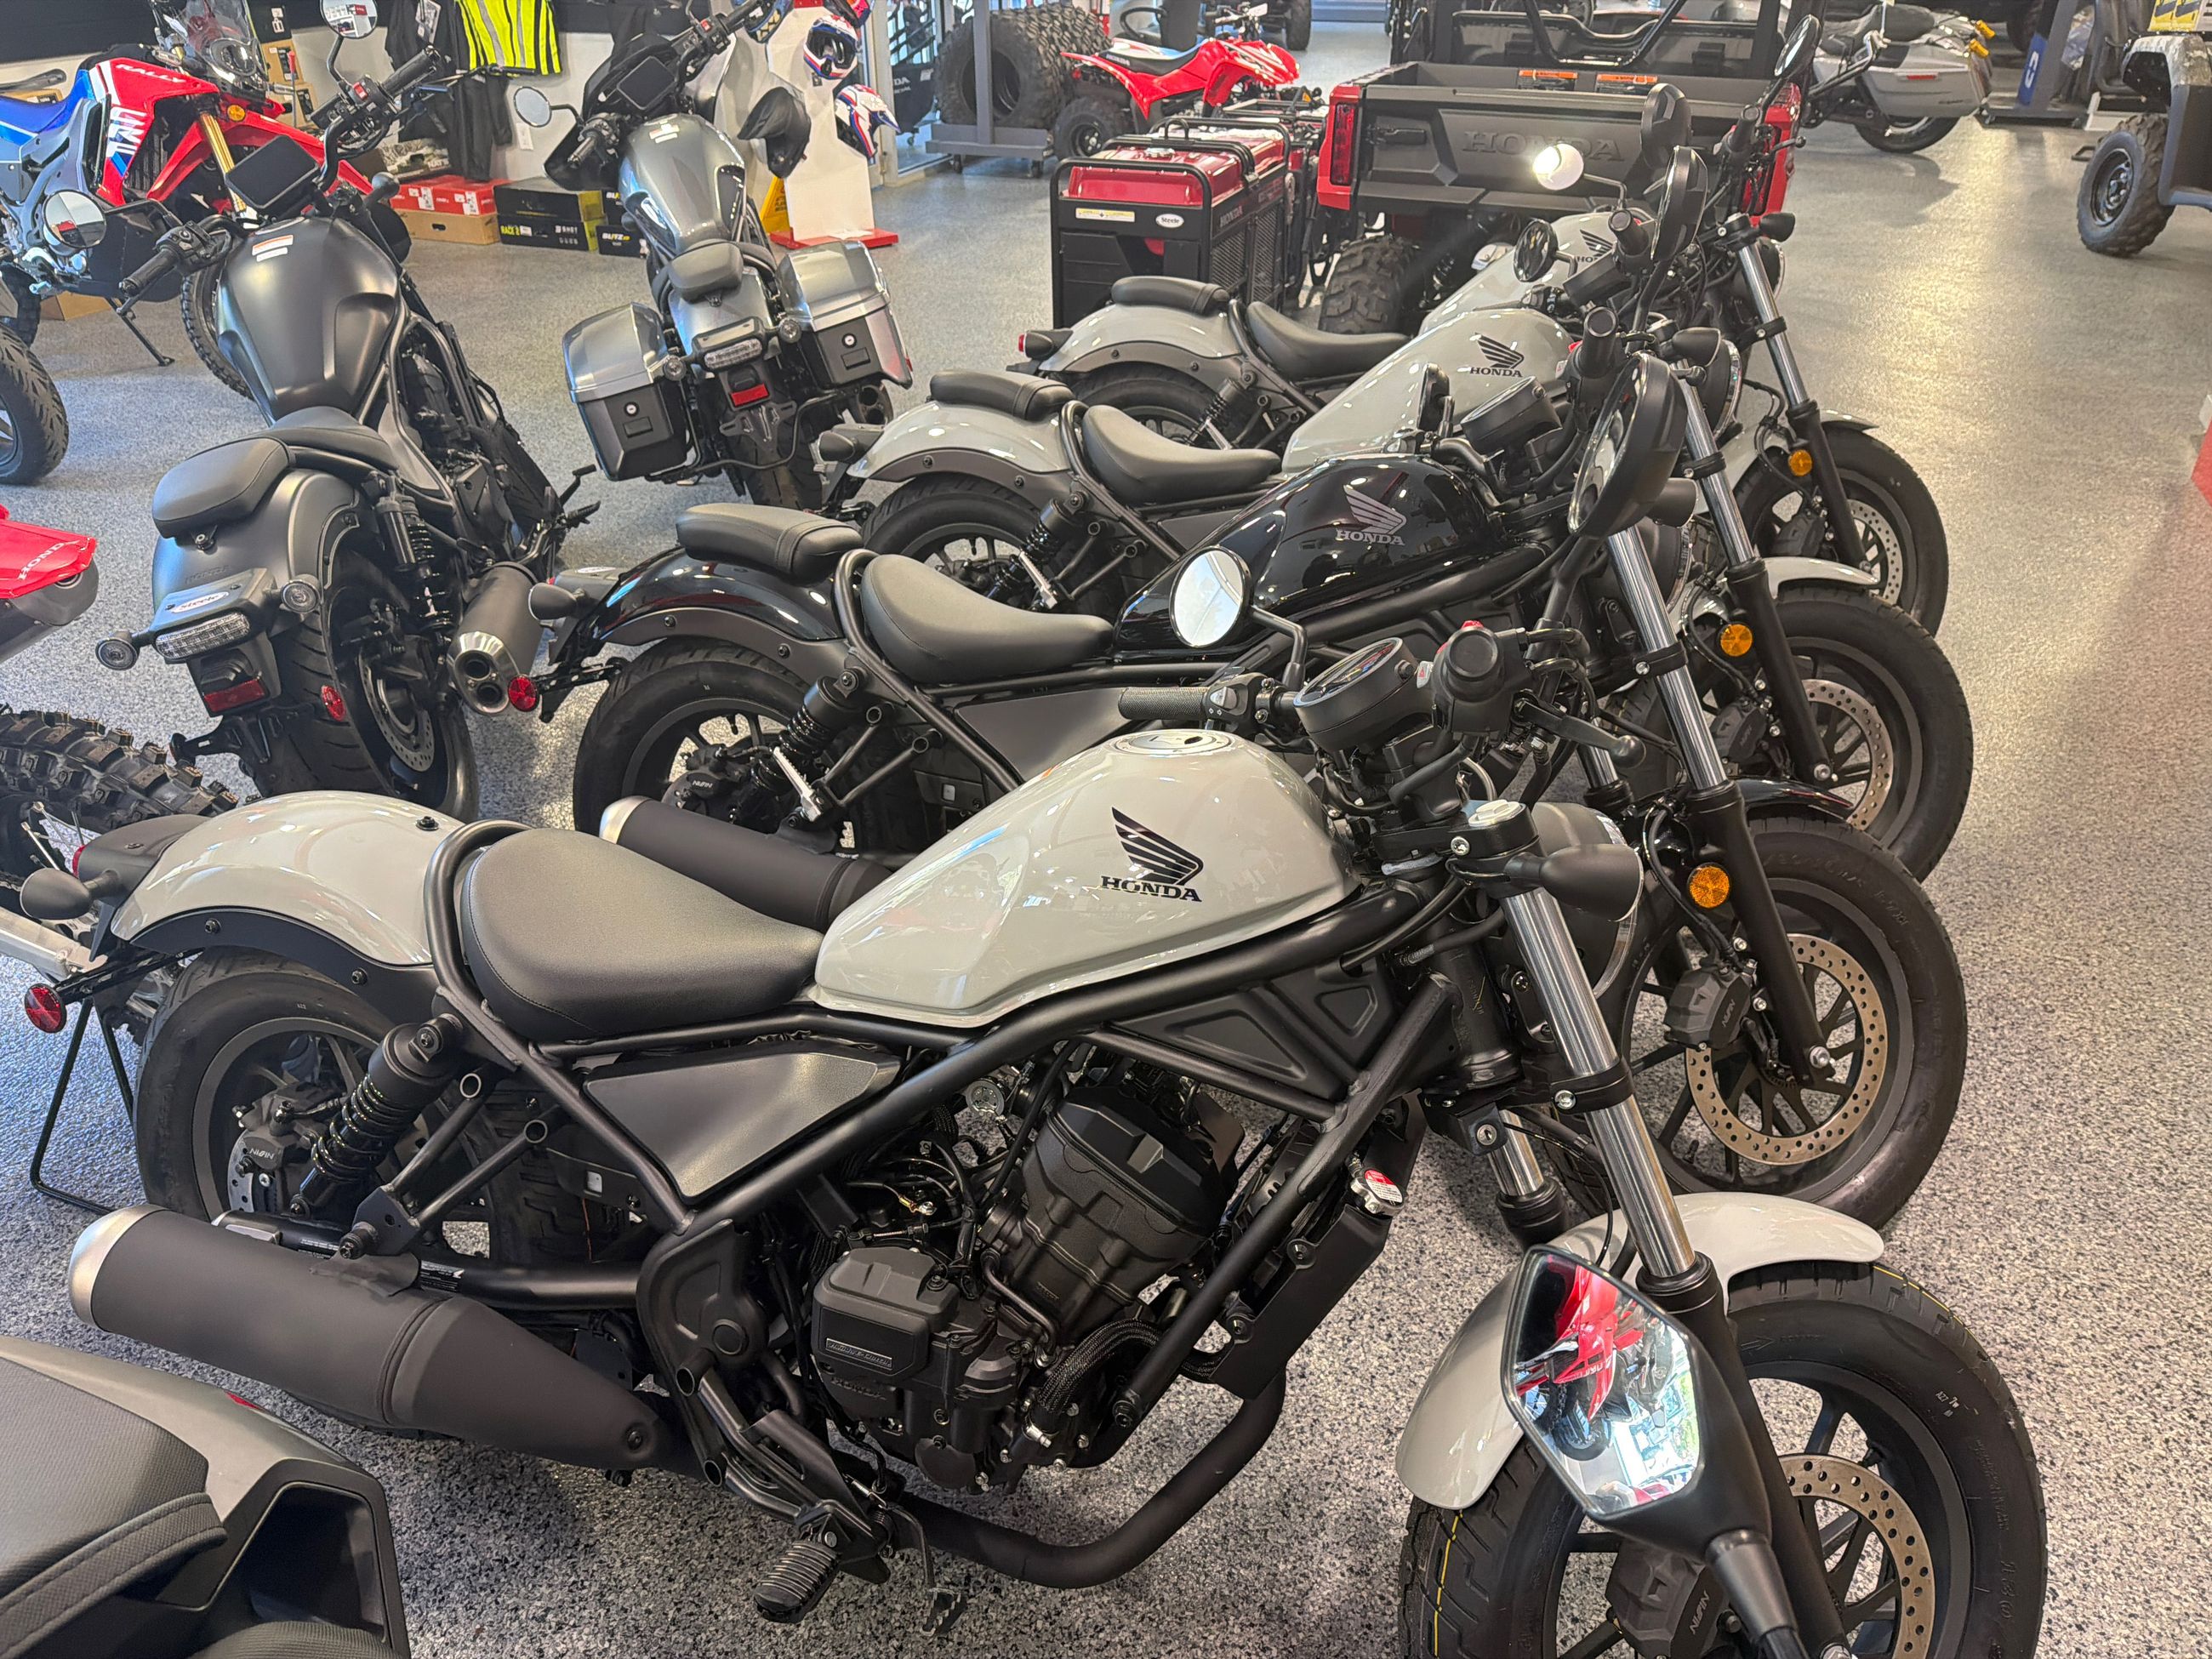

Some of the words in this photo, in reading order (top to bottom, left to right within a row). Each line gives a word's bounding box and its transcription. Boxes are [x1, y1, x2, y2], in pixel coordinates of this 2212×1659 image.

[116, 64, 186, 83] RALLY
[1469, 367, 1523, 378] HONDA
[1335, 527, 1405, 546] HONDA
[1100, 875, 1202, 903] HONDA
